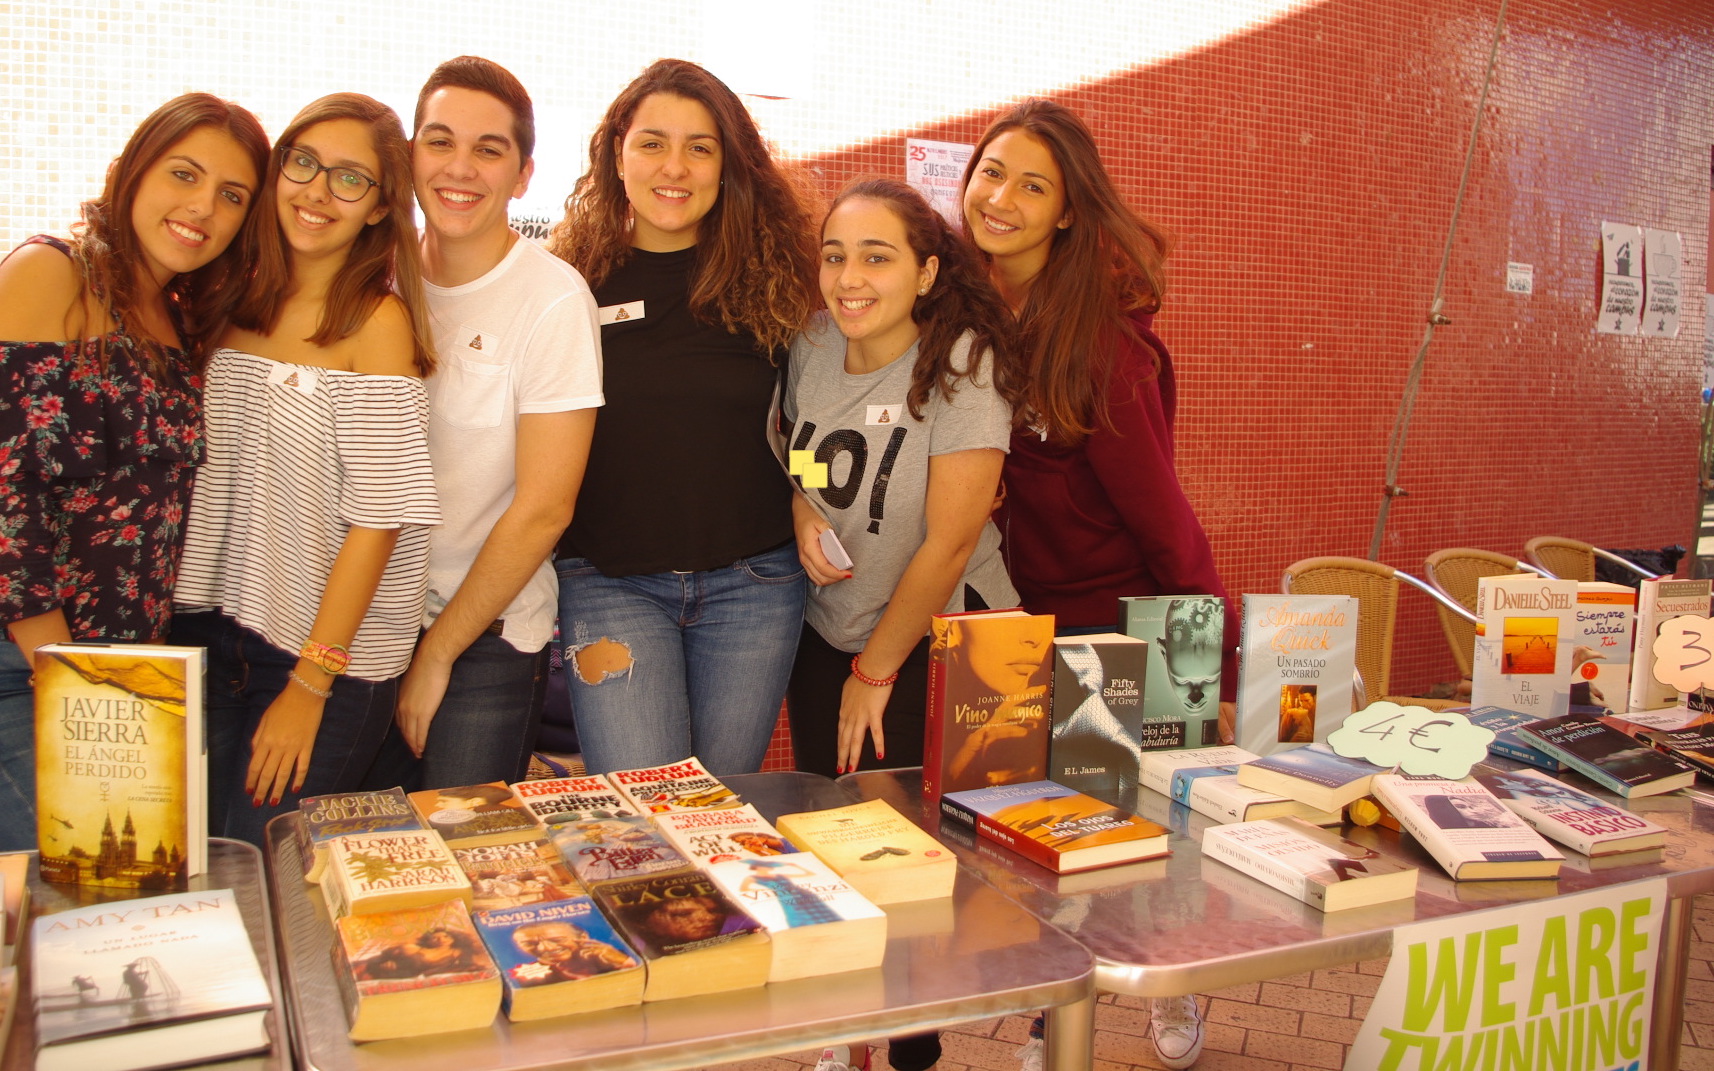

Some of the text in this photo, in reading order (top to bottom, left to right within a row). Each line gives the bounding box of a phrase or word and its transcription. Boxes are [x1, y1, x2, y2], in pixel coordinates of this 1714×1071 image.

[910, 145, 926, 161] 25
[922, 163, 940, 177] SUS
[1493, 586, 1572, 611] DANIELLE STEEL
[1656, 598, 1708, 613] Secuestrados
[1258, 602, 1345, 628] Amanda
[1576, 610, 1626, 625] Siempre
[1583, 623, 1625, 635] estarás
[1271, 625, 1338, 654] Quick
[1601, 636, 1617, 647] tú
[1680, 630, 1711, 671] 3
[1293, 658, 1326, 668] PASADO
[1280, 667, 1320, 678] SOMBRÍO
[1111, 678, 1136, 689] Fifty
[1521, 681, 1532, 691] EL
[978, 692, 1044, 705] JOANNE HARRIS
[1103, 687, 1139, 697] Shades
[1512, 694, 1540, 705] VIAJE
[60, 696, 147, 722] JAVIER
[1108, 697, 1138, 706] of Grey
[955, 703, 989, 723] Vino
[64, 719, 149, 745] SIERRA
[1160, 724, 1169, 735] de
[1172, 723, 1179, 734] la
[1539, 726, 1565, 737] Amor
[1563, 726, 1606, 742] perdición
[1141, 735, 1179, 747] abiduría
[64, 744, 146, 763] EL ÁNGEL
[65, 762, 147, 780] PERDIDO
[615, 761, 694, 779] ROBERT
[619, 769, 705, 785] LUDLUM
[1080, 766, 1105, 775] James
[517, 778, 598, 790] ROBERT
[629, 778, 711, 793] AQUITAINE
[1292, 770, 1338, 787] Donnelly
[520, 783, 609, 797] LUDLUM
[1441, 786, 1487, 794] Nadia
[316, 794, 397, 811] JACKIE
[529, 795, 617, 810] BOURNE
[533, 800, 621, 816] IDENTITY
[310, 803, 411, 824] COLLINS
[670, 809, 745, 820] BARBARA
[1548, 806, 1622, 824] INSTINTO
[674, 818, 757, 830] BRADFORD
[1040, 815, 1116, 832] LOS OJOS
[1050, 820, 1135, 839] DEL TUAREG
[1568, 815, 1647, 836] BÁSICO
[341, 836, 350, 844] A
[343, 835, 431, 852] FLOWER
[689, 834, 723, 844] ACT
[388, 849, 445, 863] FREE
[455, 841, 539, 858] NORAH
[691, 846, 742, 857] WILL
[399, 867, 451, 879] SARAH
[652, 874, 706, 886] Conran
[360, 874, 458, 892] HARRISON
[610, 881, 718, 907] LACE
[45, 897, 222, 934] AMY TAN
[479, 911, 536, 925] DAVID
[539, 902, 592, 917] NIVEN
[1401, 897, 1652, 1033] WE ARE
[1377, 992, 1645, 1071] TWINNING
